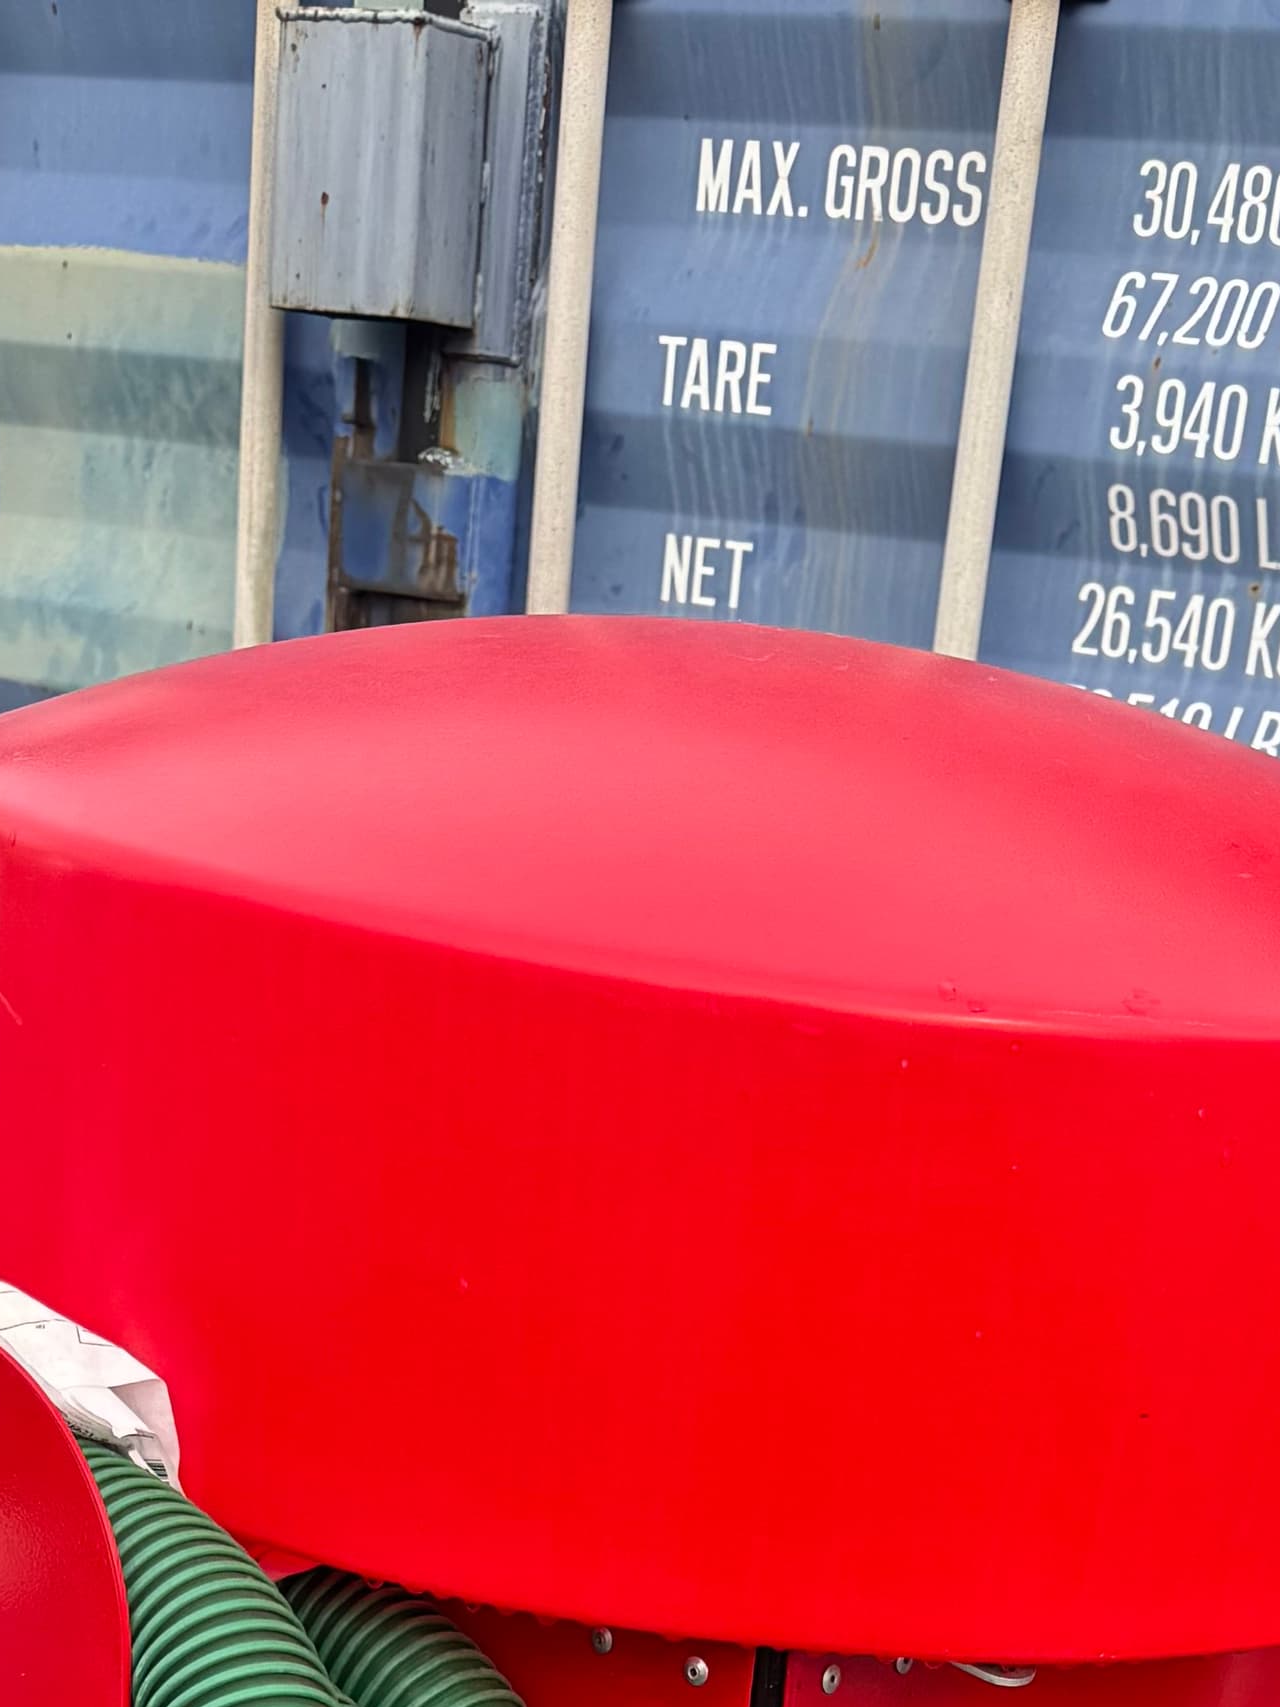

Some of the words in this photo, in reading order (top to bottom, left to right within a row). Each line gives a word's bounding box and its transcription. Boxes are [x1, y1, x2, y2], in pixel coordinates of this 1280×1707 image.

[695, 138, 810, 219] MAX.
[824, 144, 988, 228] GROSS
[658, 334, 778, 416] TARE
[1108, 373, 1247, 462] 3,940
[1107, 483, 1241, 564] 8,690
[660, 533, 754, 609] NET
[1071, 582, 1237, 672] 26,540
